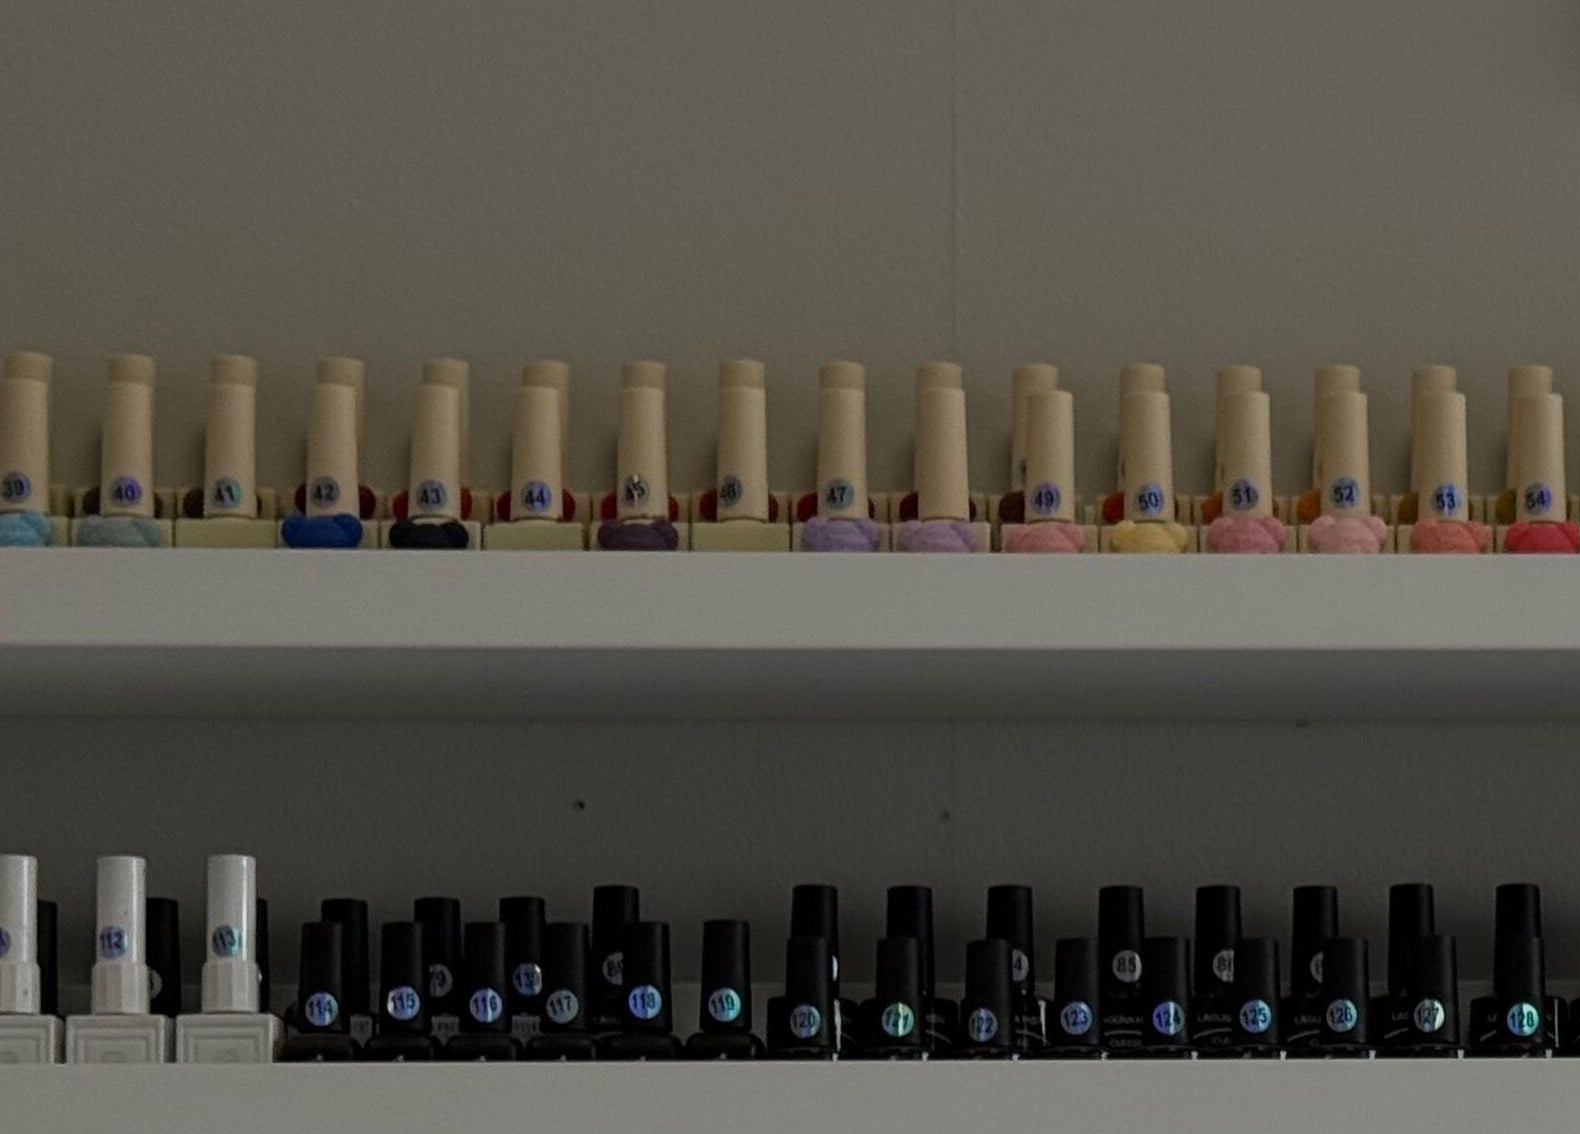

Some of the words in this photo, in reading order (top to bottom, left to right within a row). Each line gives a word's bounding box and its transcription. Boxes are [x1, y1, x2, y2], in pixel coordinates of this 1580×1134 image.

[3, 480, 26, 498] 39
[112, 483, 136, 500] 40
[313, 481, 335, 501] 42
[419, 486, 442, 505] 43
[524, 486, 547, 506] 44
[826, 483, 848, 504] 47
[1033, 488, 1056, 508] 49
[1230, 485, 1254, 505] 51
[1332, 484, 1356, 504] 52
[1137, 491, 1160, 511] 50
[1435, 490, 1459, 510] 53
[1525, 489, 1547, 509] 54
[100, 929, 124, 948] 112
[1117, 956, 1137, 973] 85
[391, 993, 417, 1012] 115
[473, 995, 498, 1013] 116
[550, 996, 574, 1014] 117
[792, 1010, 817, 1028] 120
[971, 1016, 994, 1034] 122
[1063, 1009, 1088, 1027] 123
[1242, 1006, 1268, 1026] 125
[1417, 1006, 1440, 1025] 127
[1511, 1009, 1535, 1028] 128
